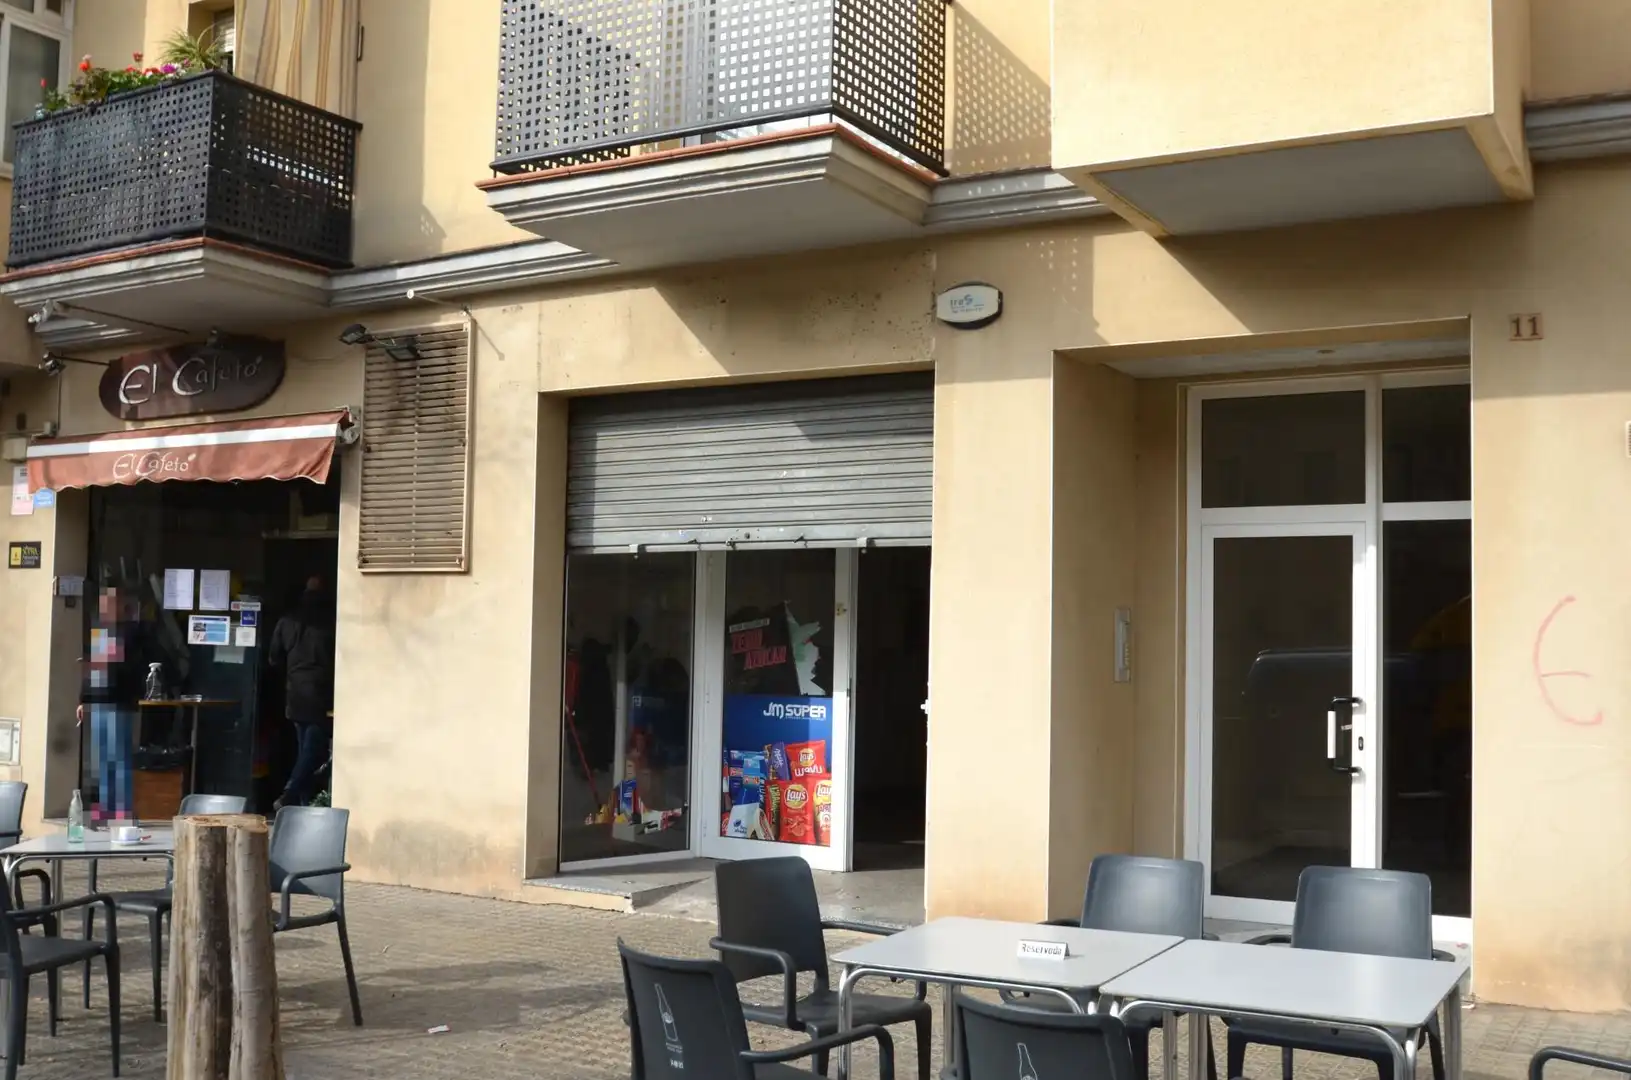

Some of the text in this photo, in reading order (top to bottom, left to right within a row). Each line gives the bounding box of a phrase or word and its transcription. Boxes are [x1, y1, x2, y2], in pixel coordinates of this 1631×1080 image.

[1511, 316, 1539, 337] 11
[119, 363, 157, 405] El
[112, 451, 190, 479] El Cafeto
